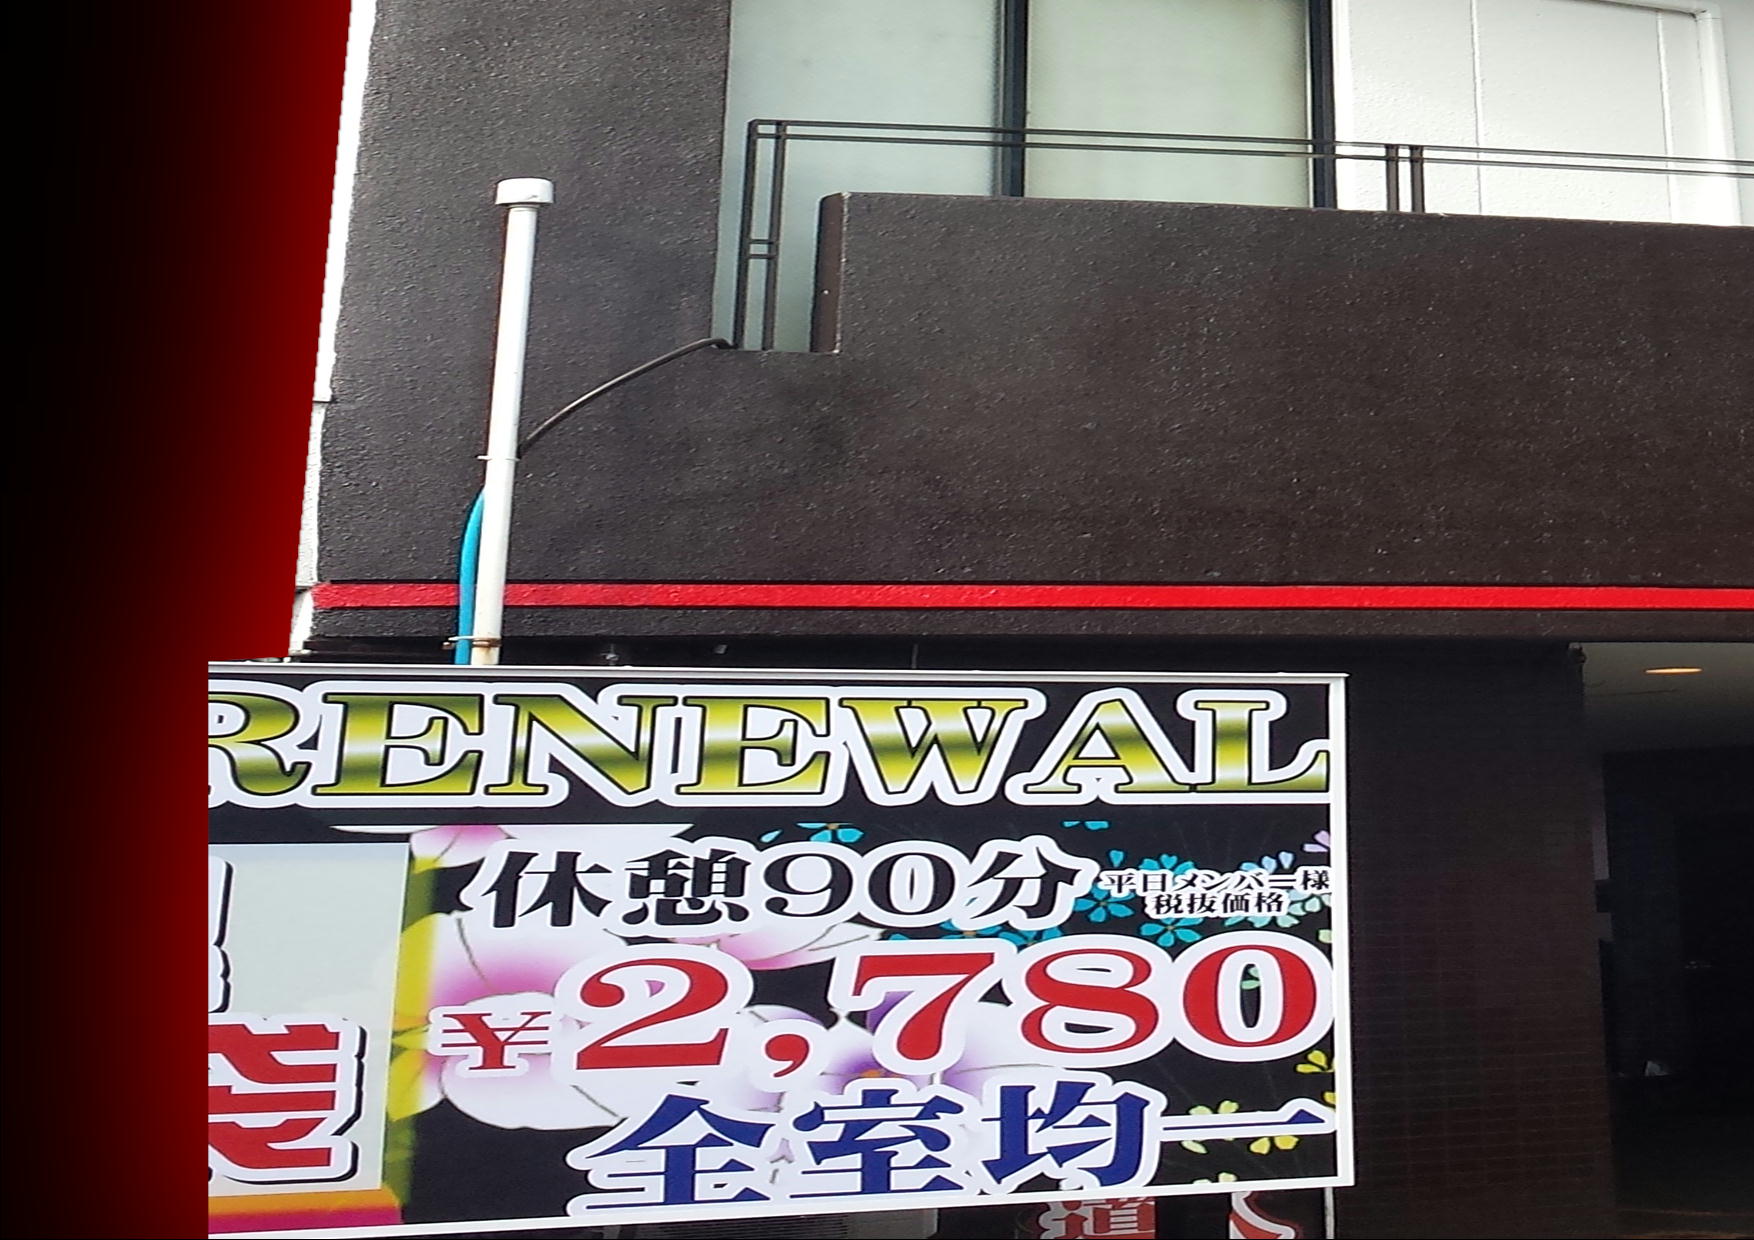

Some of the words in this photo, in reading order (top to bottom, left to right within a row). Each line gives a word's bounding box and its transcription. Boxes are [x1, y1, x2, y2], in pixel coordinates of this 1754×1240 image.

[208, 691, 1330, 797] RENEWAL
[482, 847, 1079, 928] 休憩90分
[1104, 869, 1331, 894] 平日メンバー様
[1152, 892, 1285, 915] 税抜価格
[440, 944, 1318, 1078] ¥2,780
[584, 1082, 1326, 1207] 全室均一
